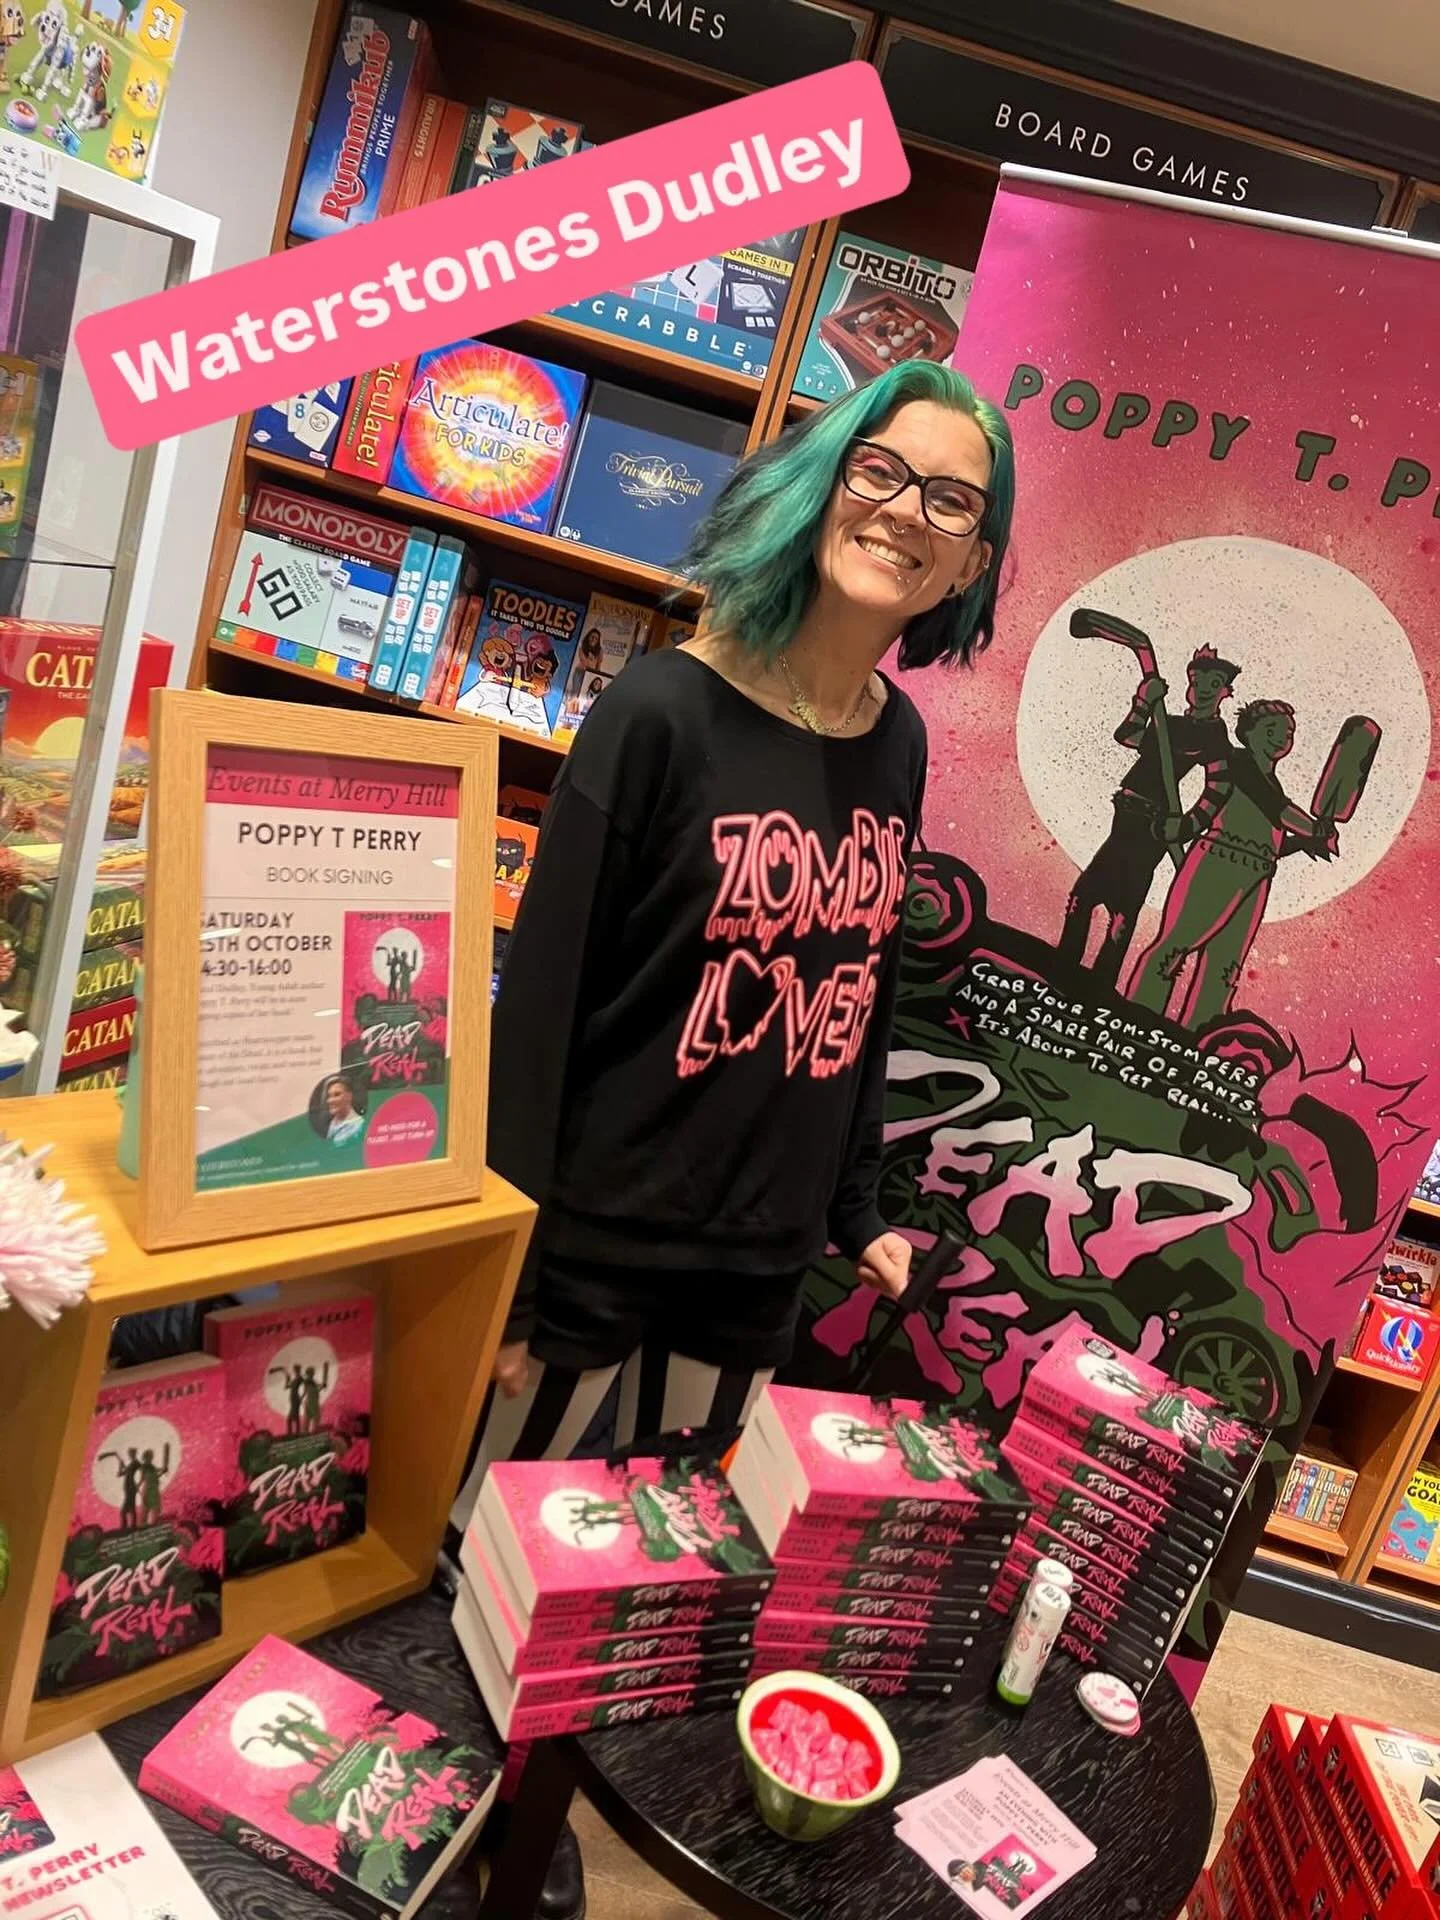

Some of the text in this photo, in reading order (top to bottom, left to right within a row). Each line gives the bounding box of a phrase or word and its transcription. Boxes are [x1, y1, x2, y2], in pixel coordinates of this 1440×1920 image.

[319, 30, 390, 222] Rummikub
[375, 114, 395, 157] PRIME
[414, 98, 441, 159] DRAUGHTS
[995, 102, 1253, 204] BOARD GAMES
[410, 379, 569, 449] Articulate!
[1004, 363, 1251, 461] POPPY
[1295, 430, 1350, 492] T.
[435, 423, 526, 467] FOR KIDS
[259, 497, 406, 555] MONOPOLY
[257, 567, 303, 621] GO
[491, 588, 577, 632] TOODLES
[25, 651, 95, 690] CAT
[208, 765, 448, 810] Events at Merry Hill
[237, 822, 422, 851] POPPY T PERRY
[266, 866, 393, 885] BOOK SIGNING
[87, 899, 145, 940] CATA
[200, 912, 294, 929] ATURDAY
[246, 936, 333, 951] OCTOBER
[971, 962, 1025, 994] GRAB
[1033, 981, 1085, 1016] YOUR
[64, 1010, 138, 1057] CATAN
[360, 1022, 422, 1054] DEAD
[955, 983, 998, 1011] AND
[1003, 998, 1018, 1016] A
[1024, 1005, 1089, 1040] SPARE
[1095, 1029, 1137, 1060] PAIR
[1147, 1056, 1181, 1079] OF
[1015, 1026, 1076, 1060] ABOUT
[1087, 1051, 1109, 1075] TO
[1118, 1066, 1152, 1090] GET
[61, 1066, 119, 1094] ATAN
[368, 1046, 428, 1083] REAL
[811, 1223, 1166, 1410] REA
[248, 1452, 335, 1510] DEAD
[262, 1490, 346, 1545] REAL
[74, 1547, 181, 1620] DEAD
[90, 1586, 193, 1657] REAL
[335, 1744, 406, 1840] DEAD
[30, 1842, 100, 1882] PERRY
[236, 1826, 287, 1861] DEAD
[2, 1845, 146, 1912] NEWSLETTER
